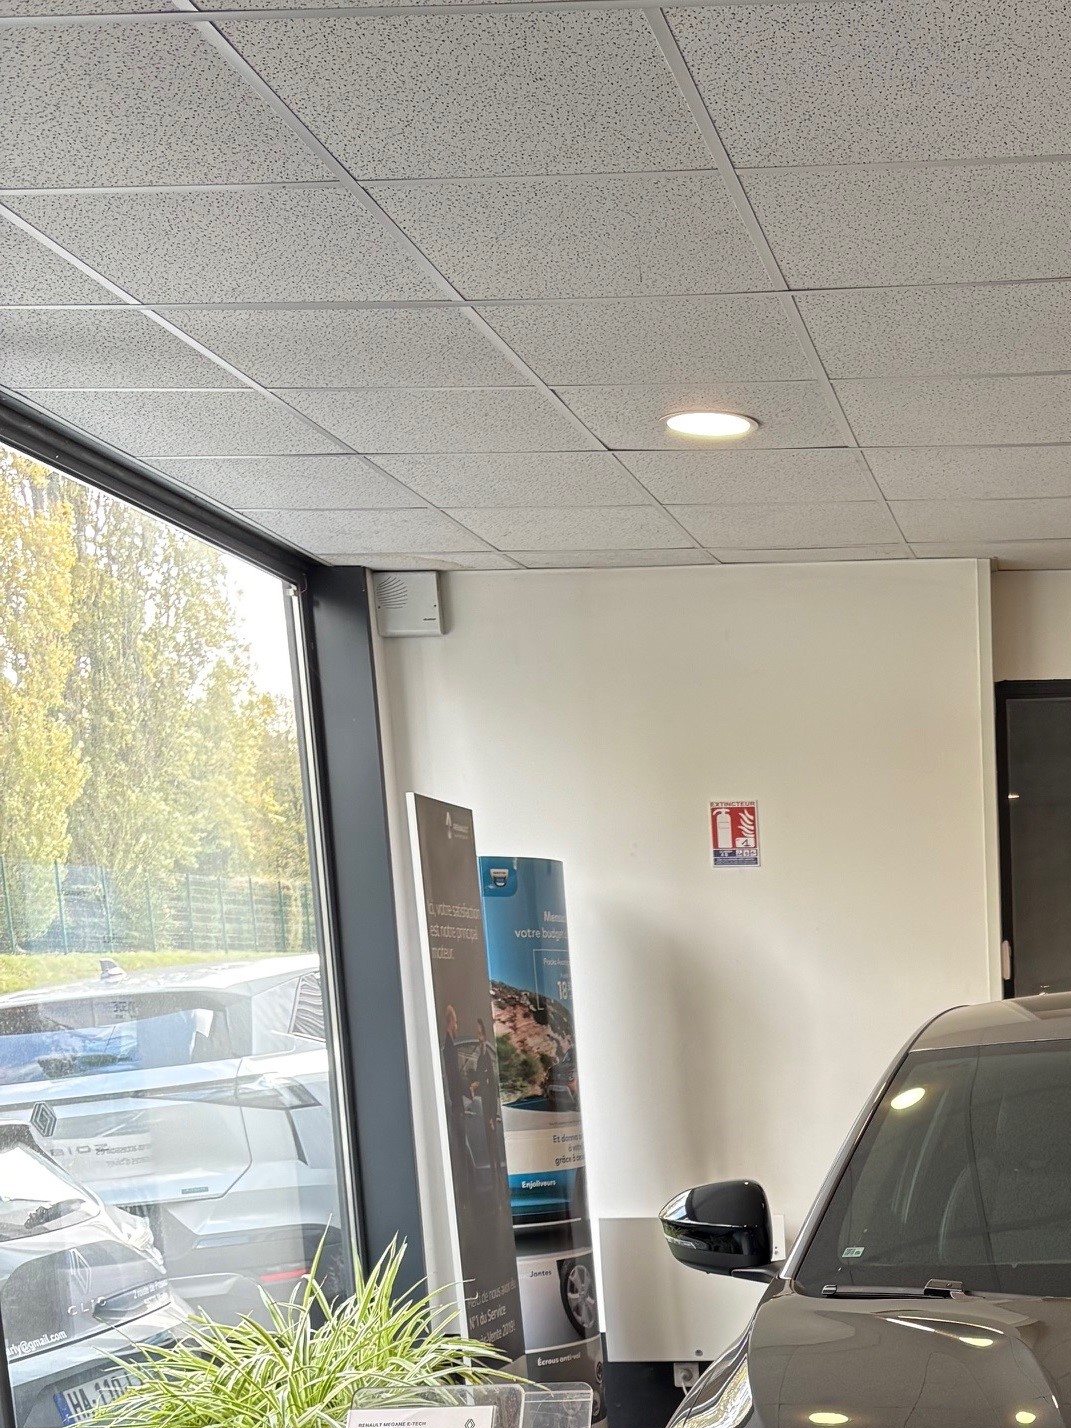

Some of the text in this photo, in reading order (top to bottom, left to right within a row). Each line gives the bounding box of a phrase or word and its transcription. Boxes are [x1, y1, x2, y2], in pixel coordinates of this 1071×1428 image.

[514, 929, 541, 938] votre
[521, 1180, 556, 1189] Enjoliveurs
[530, 1270, 551, 1278] Jantes
[487, 1304, 507, 1321] Service
[537, 1356, 559, 1366] Écrous
